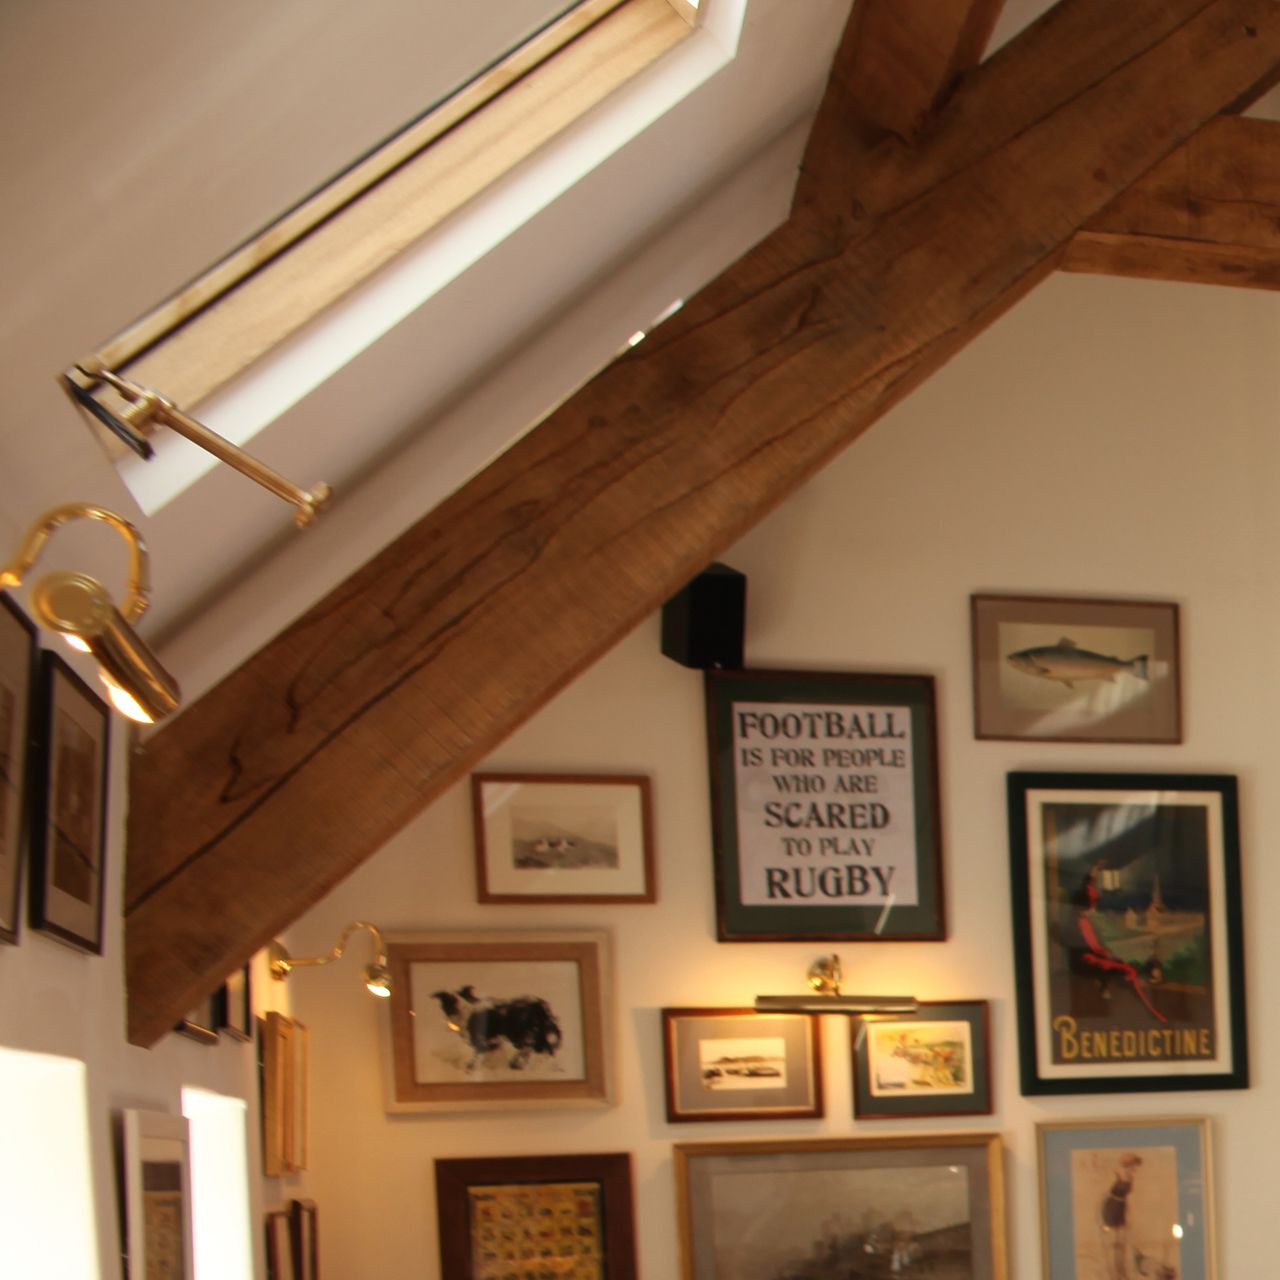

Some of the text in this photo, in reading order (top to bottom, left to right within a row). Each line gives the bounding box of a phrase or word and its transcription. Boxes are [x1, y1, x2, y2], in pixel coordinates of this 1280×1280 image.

[737, 711, 906, 740] FOOTBALL
[741, 747, 906, 768] IS FOR PEOPLE
[772, 774, 878, 794] WHO ARE
[763, 801, 890, 829] SCARED
[781, 837, 876, 856] TO PLAY
[765, 864, 895, 899] RUGBY
